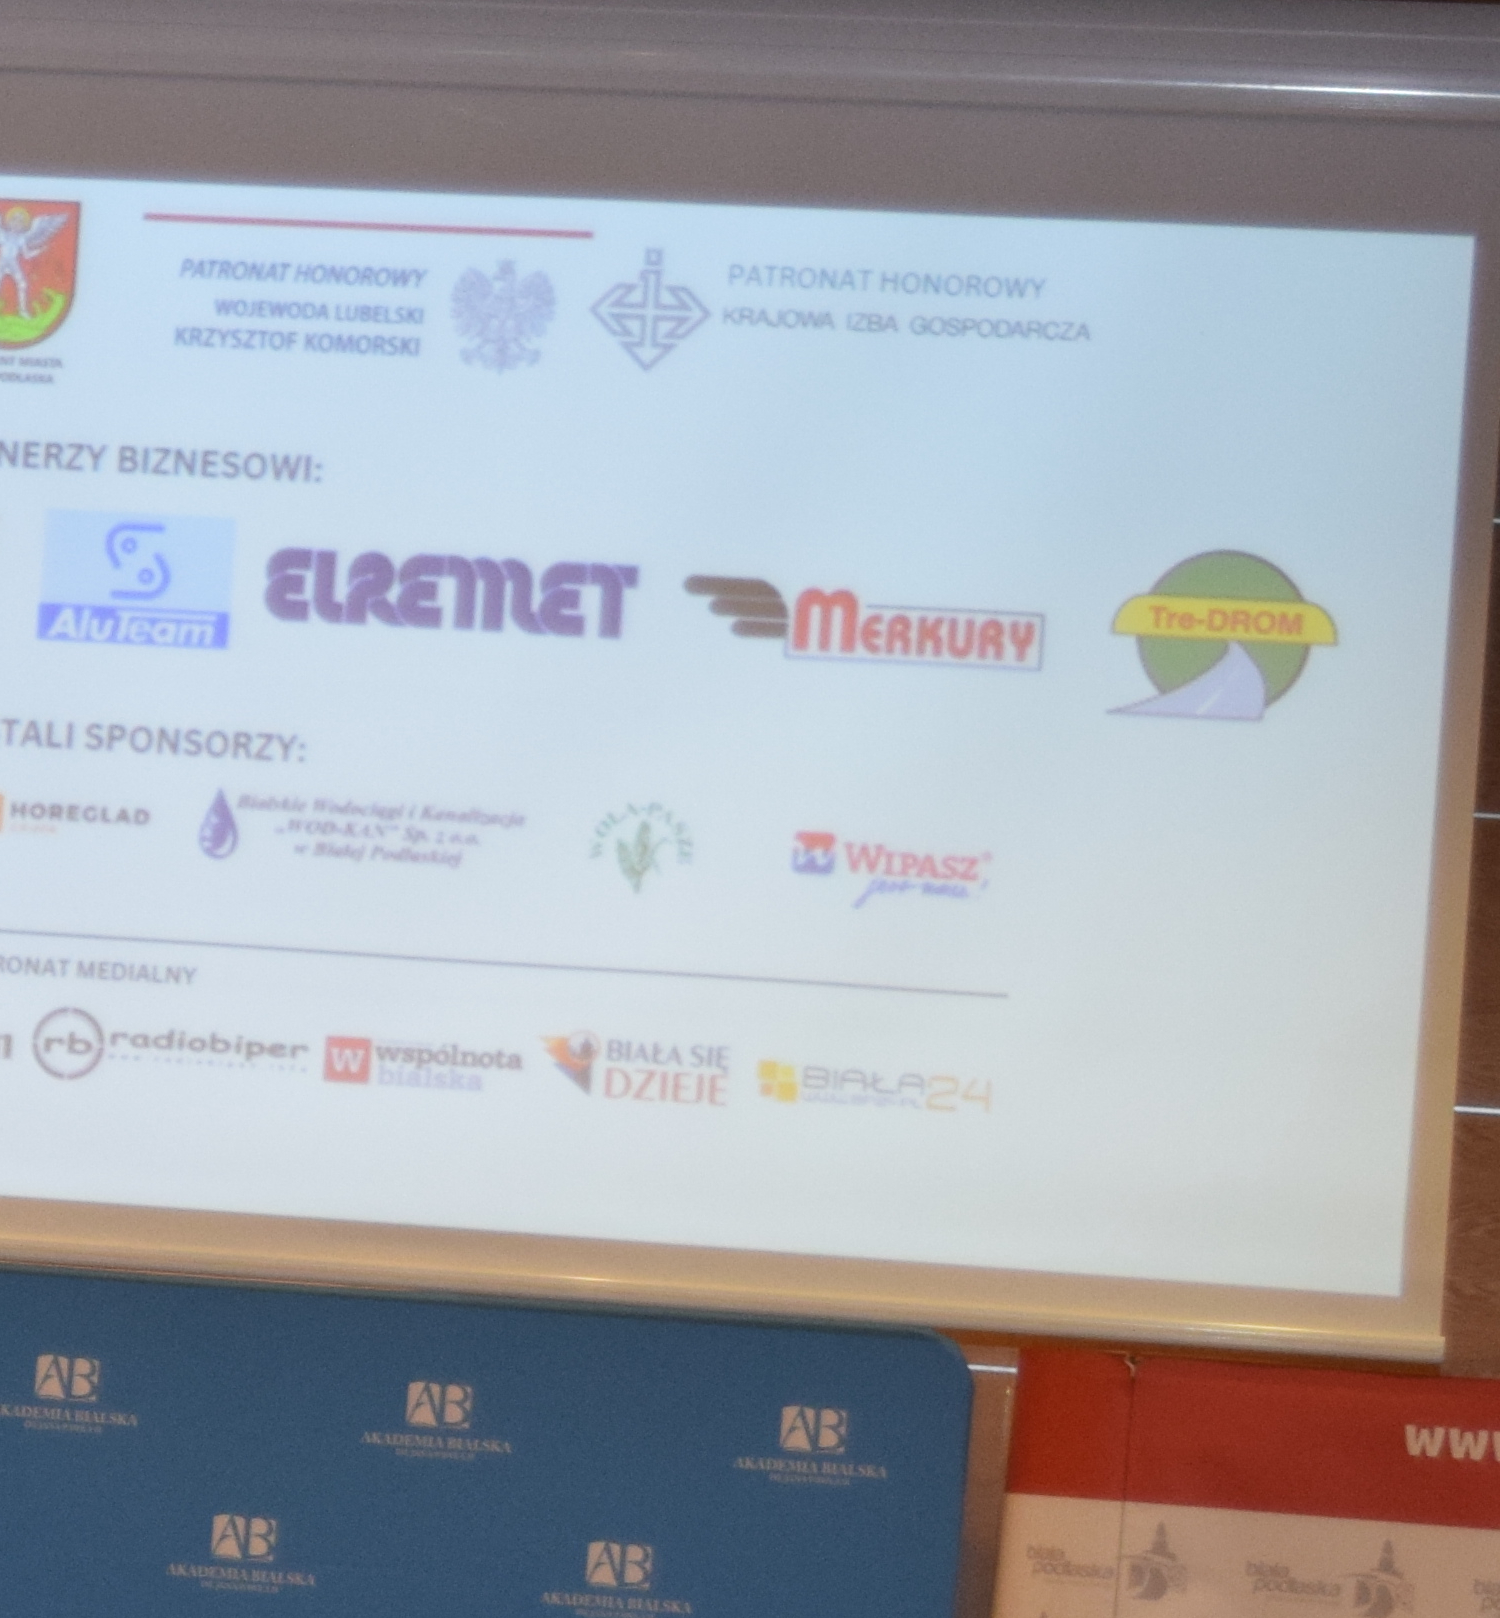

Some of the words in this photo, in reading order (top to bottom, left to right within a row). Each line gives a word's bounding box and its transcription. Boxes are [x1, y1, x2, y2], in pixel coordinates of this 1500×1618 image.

[180, 258, 291, 283] PATRONAT
[294, 264, 429, 288] HONOROWY
[727, 264, 875, 292] PATRONAT
[880, 270, 1047, 298] HONOROWY
[214, 299, 329, 321] WOJEWODA
[335, 304, 424, 325] LUBELSKI
[722, 307, 835, 330] KRAJOWA
[847, 312, 898, 333] IZBA
[909, 315, 1091, 341] GOSPODARCZA
[174, 327, 298, 350] KRZYSZTOF
[304, 331, 421, 356] KOMORSKI
[117, 444, 323, 482] BIZNESOWI:
[264, 546, 640, 640] ELREMET
[48, 607, 218, 648] AluTeam
[1148, 605, 1305, 637] Tre-DROM
[85, 722, 307, 763] SPONSORZY:
[9, 801, 150, 826] HOREGLAD
[76, 958, 198, 985] MEDIALNY
[109, 1026, 310, 1062] radiobiper
[376, 1042, 524, 1072] wspólnota
[607, 1037, 687, 1066] BIAŁA
[604, 1067, 730, 1107] DZIEJE
[74, 1407, 138, 1427] BIALSKA
[360, 1429, 443, 1449] AKADEMIA
[446, 1435, 512, 1456] BIALSKA
[732, 1455, 816, 1474] AKADEMIA
[820, 1460, 887, 1480] BIALSKA
